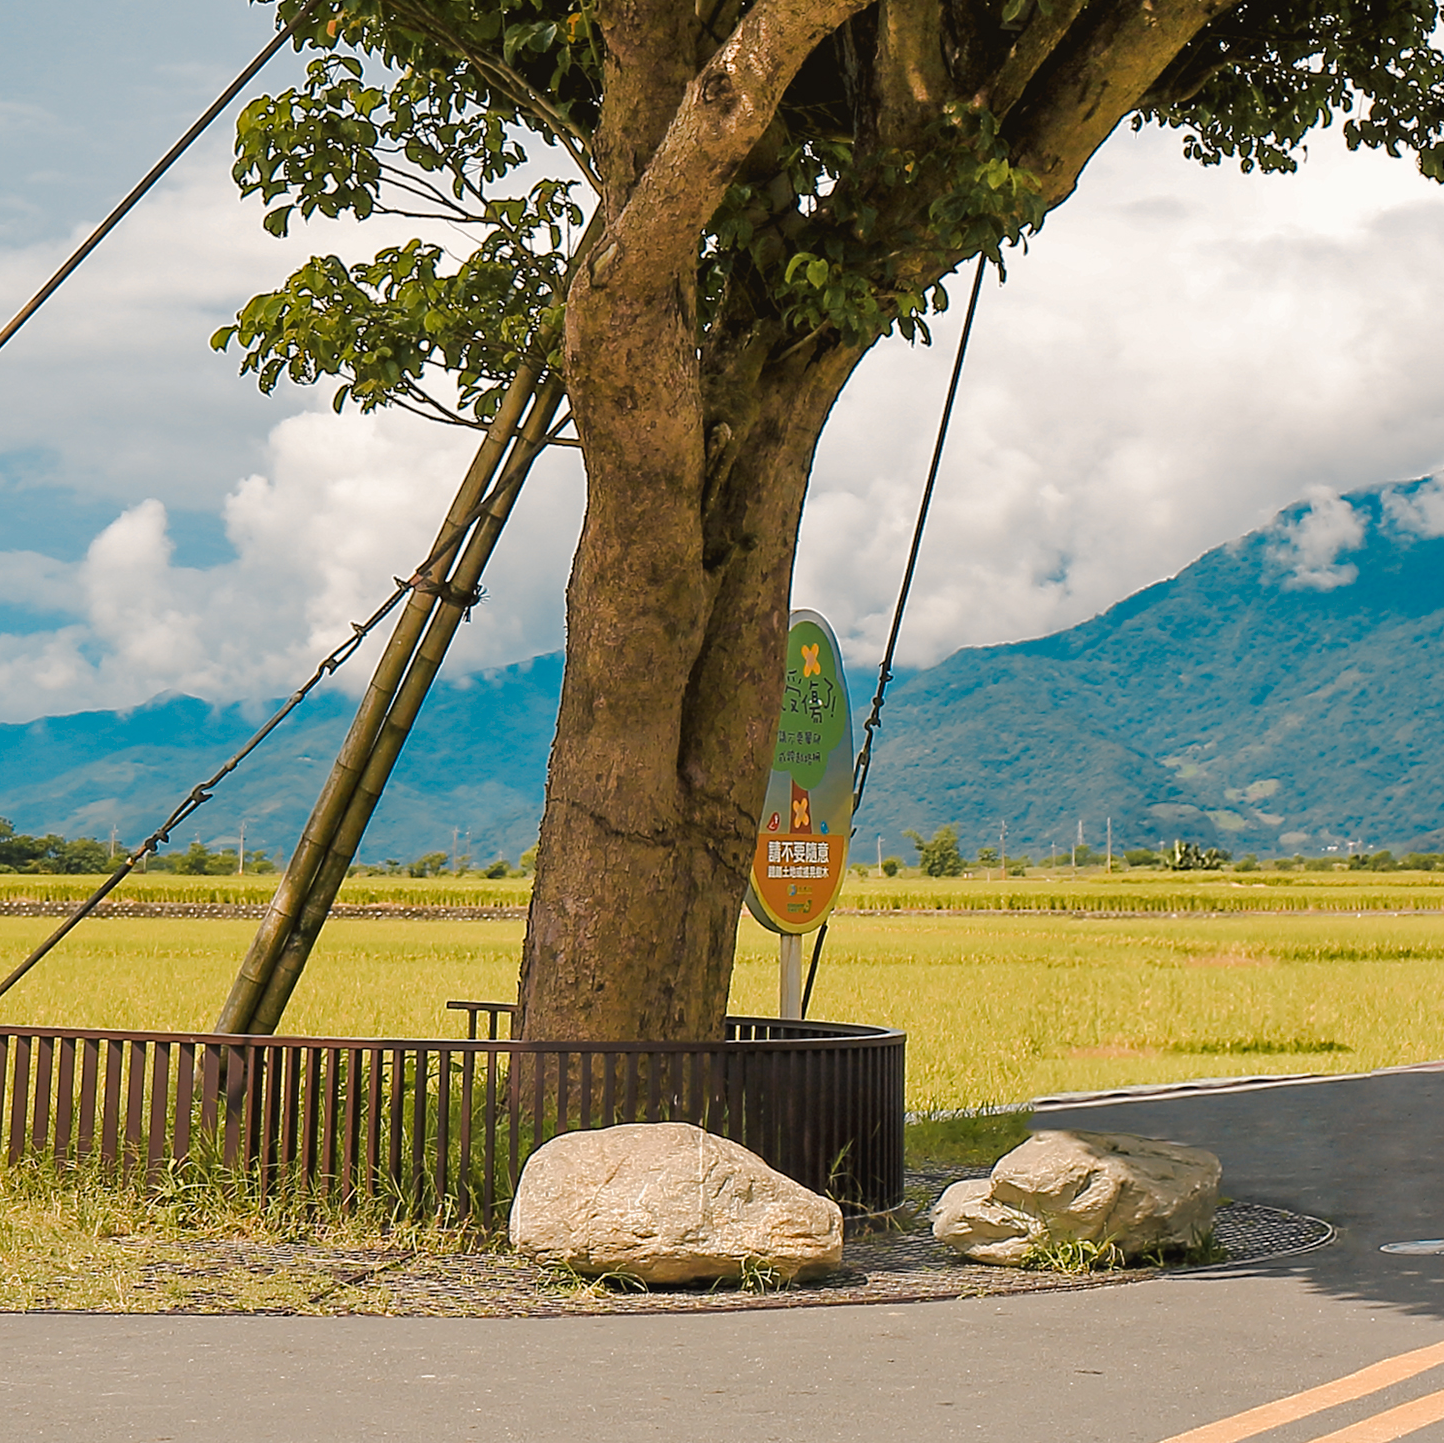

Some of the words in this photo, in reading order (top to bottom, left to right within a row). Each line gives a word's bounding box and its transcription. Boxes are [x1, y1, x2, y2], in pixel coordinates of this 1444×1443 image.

[768, 840, 829, 863] 請不要隨意
